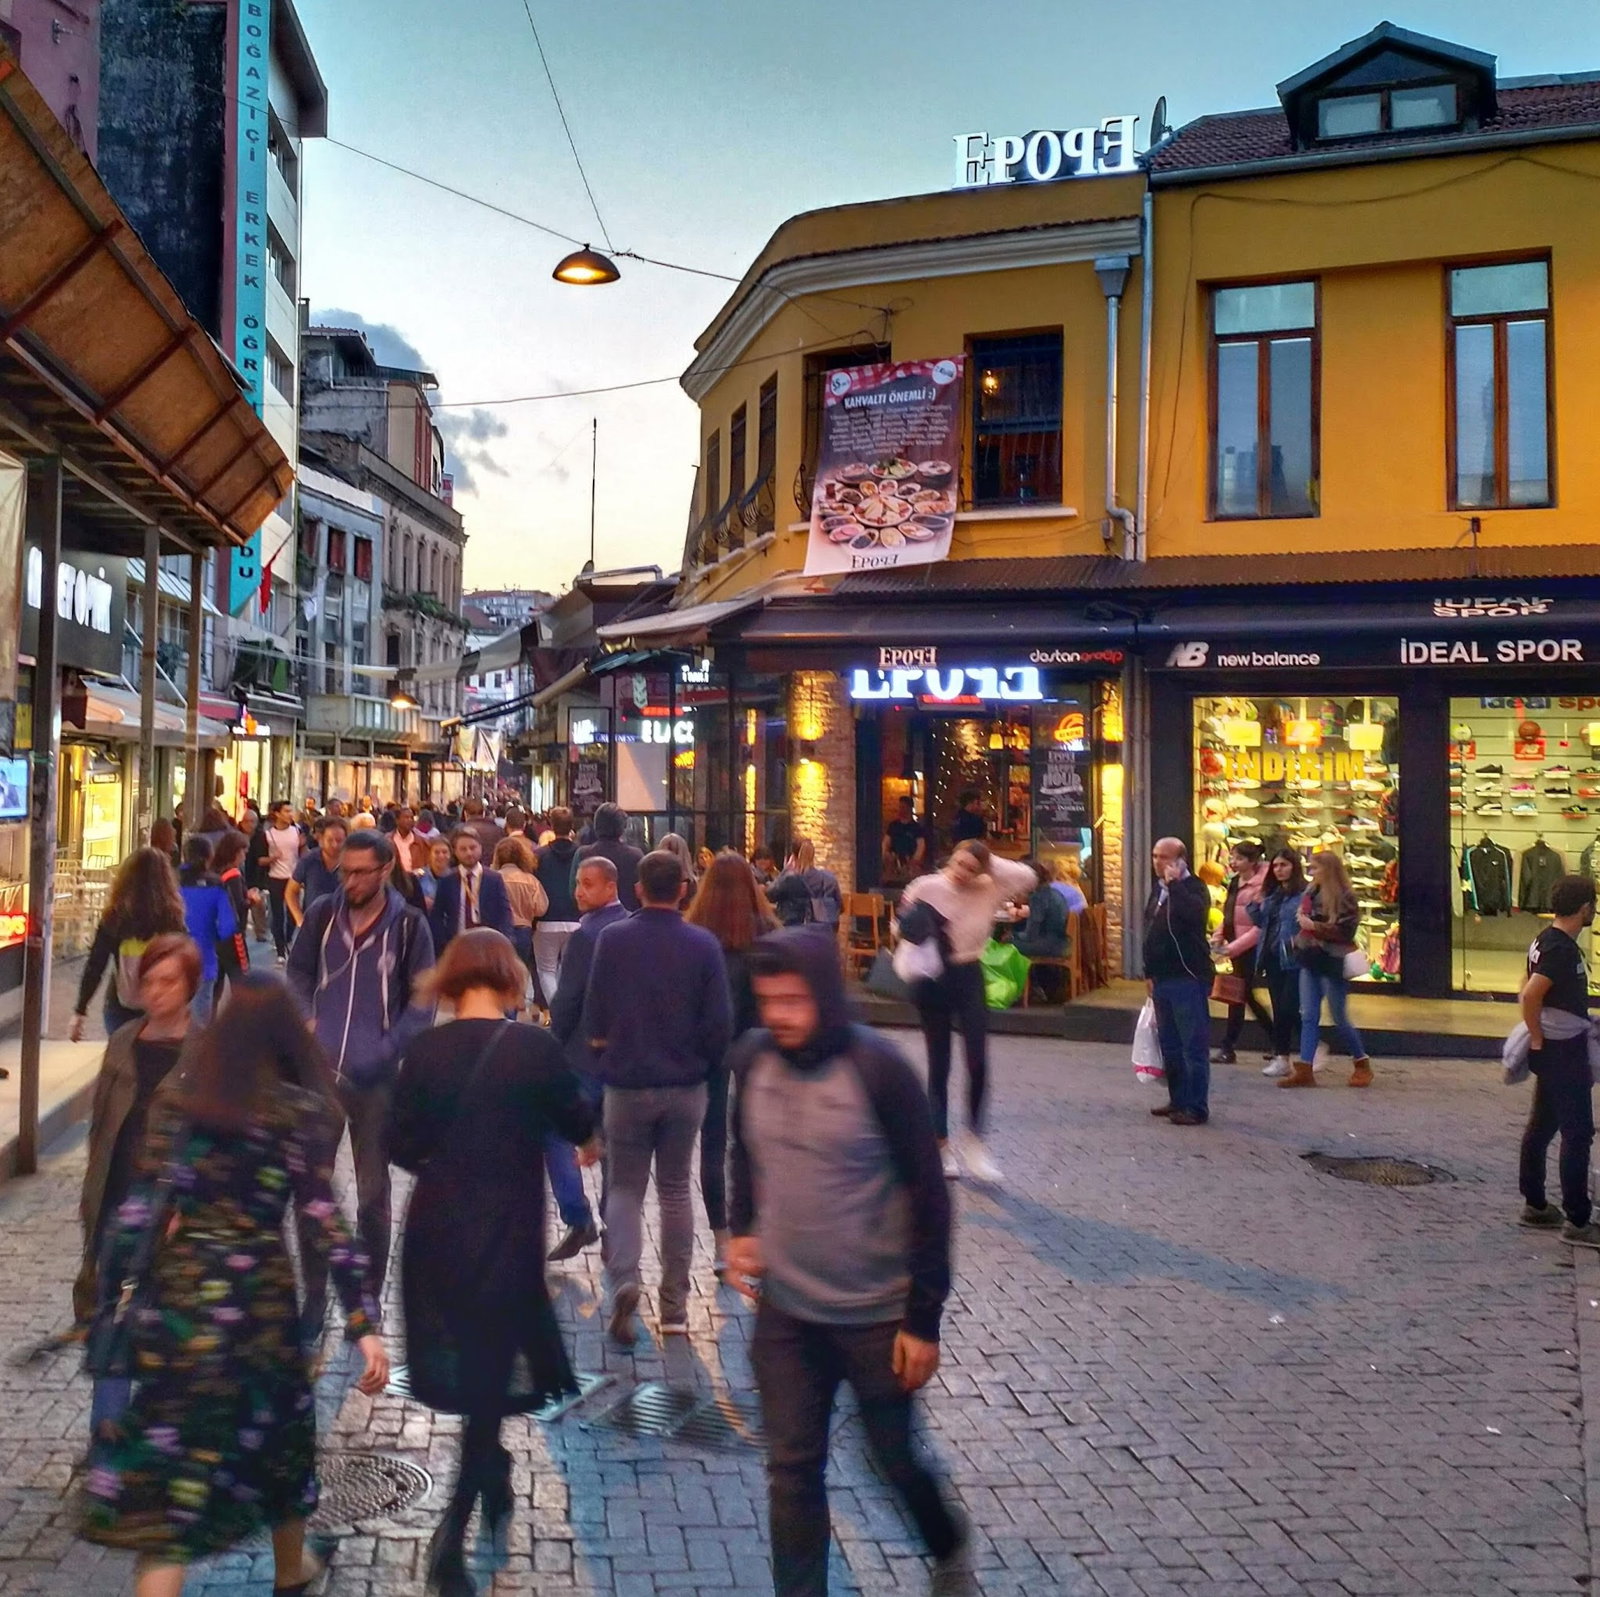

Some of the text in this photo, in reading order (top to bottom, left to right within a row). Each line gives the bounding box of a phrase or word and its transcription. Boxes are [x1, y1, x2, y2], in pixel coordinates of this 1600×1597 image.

[244, 191, 259, 288] ERKEK
[844, 393, 886, 408] KAHVALTI
[889, 387, 926, 404] ÖNEMLİ
[1217, 654, 1249, 667] new
[1252, 651, 1320, 667] balance
[1496, 639, 1584, 663] SPOR
